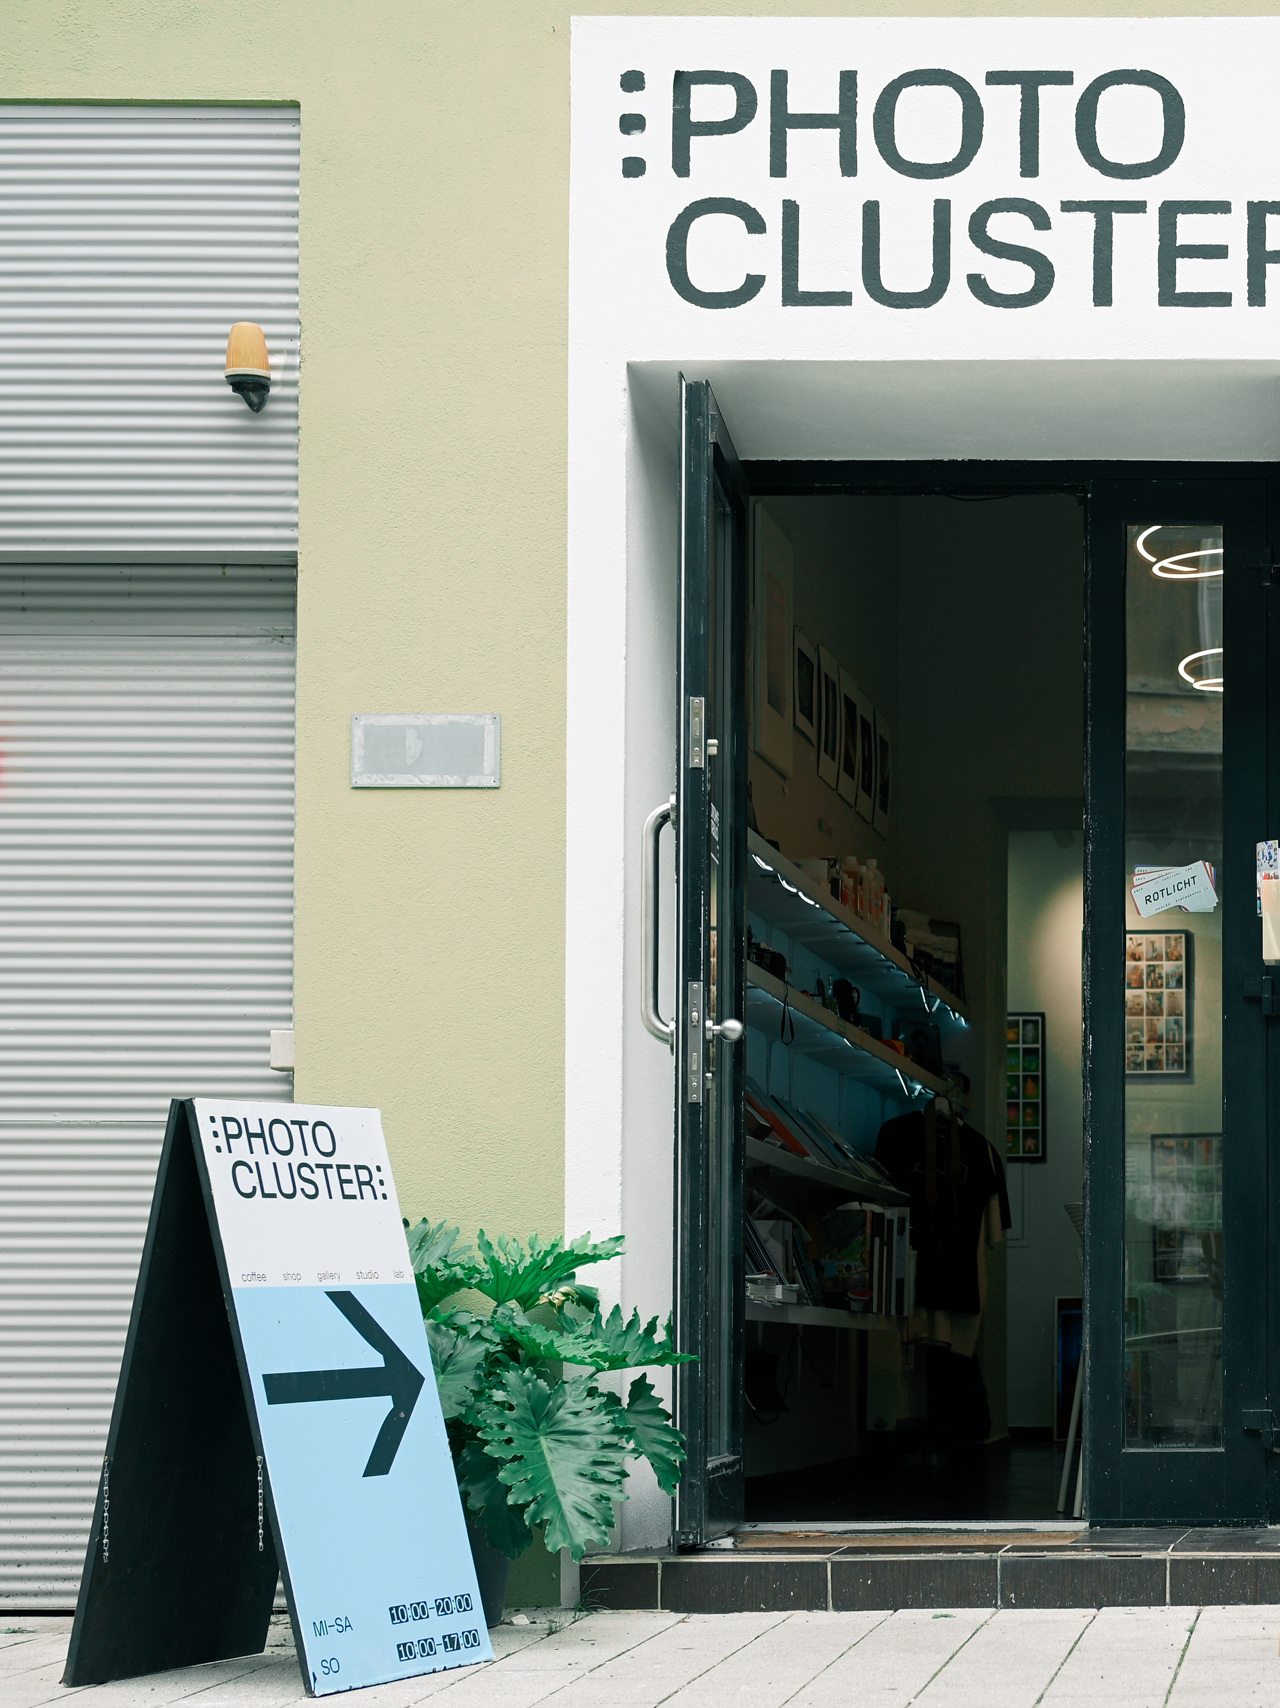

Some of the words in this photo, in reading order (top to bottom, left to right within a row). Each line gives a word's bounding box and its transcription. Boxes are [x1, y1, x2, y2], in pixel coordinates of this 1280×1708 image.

[672, 69, 1185, 180] PHOTO
[1144, 875, 1197, 905] ROTLICHT
[220, 1117, 337, 1158] PHOTO
[231, 1160, 378, 1200] CLUSTER
[241, 1271, 267, 1283] coffee
[283, 1271, 302, 1282] shop
[317, 1270, 341, 1282] gallery
[355, 1269, 379, 1280] studio
[392, 1269, 405, 1279] lab
[312, 1616, 354, 1638] MI-SA
[320, 1657, 340, 1676] SO
